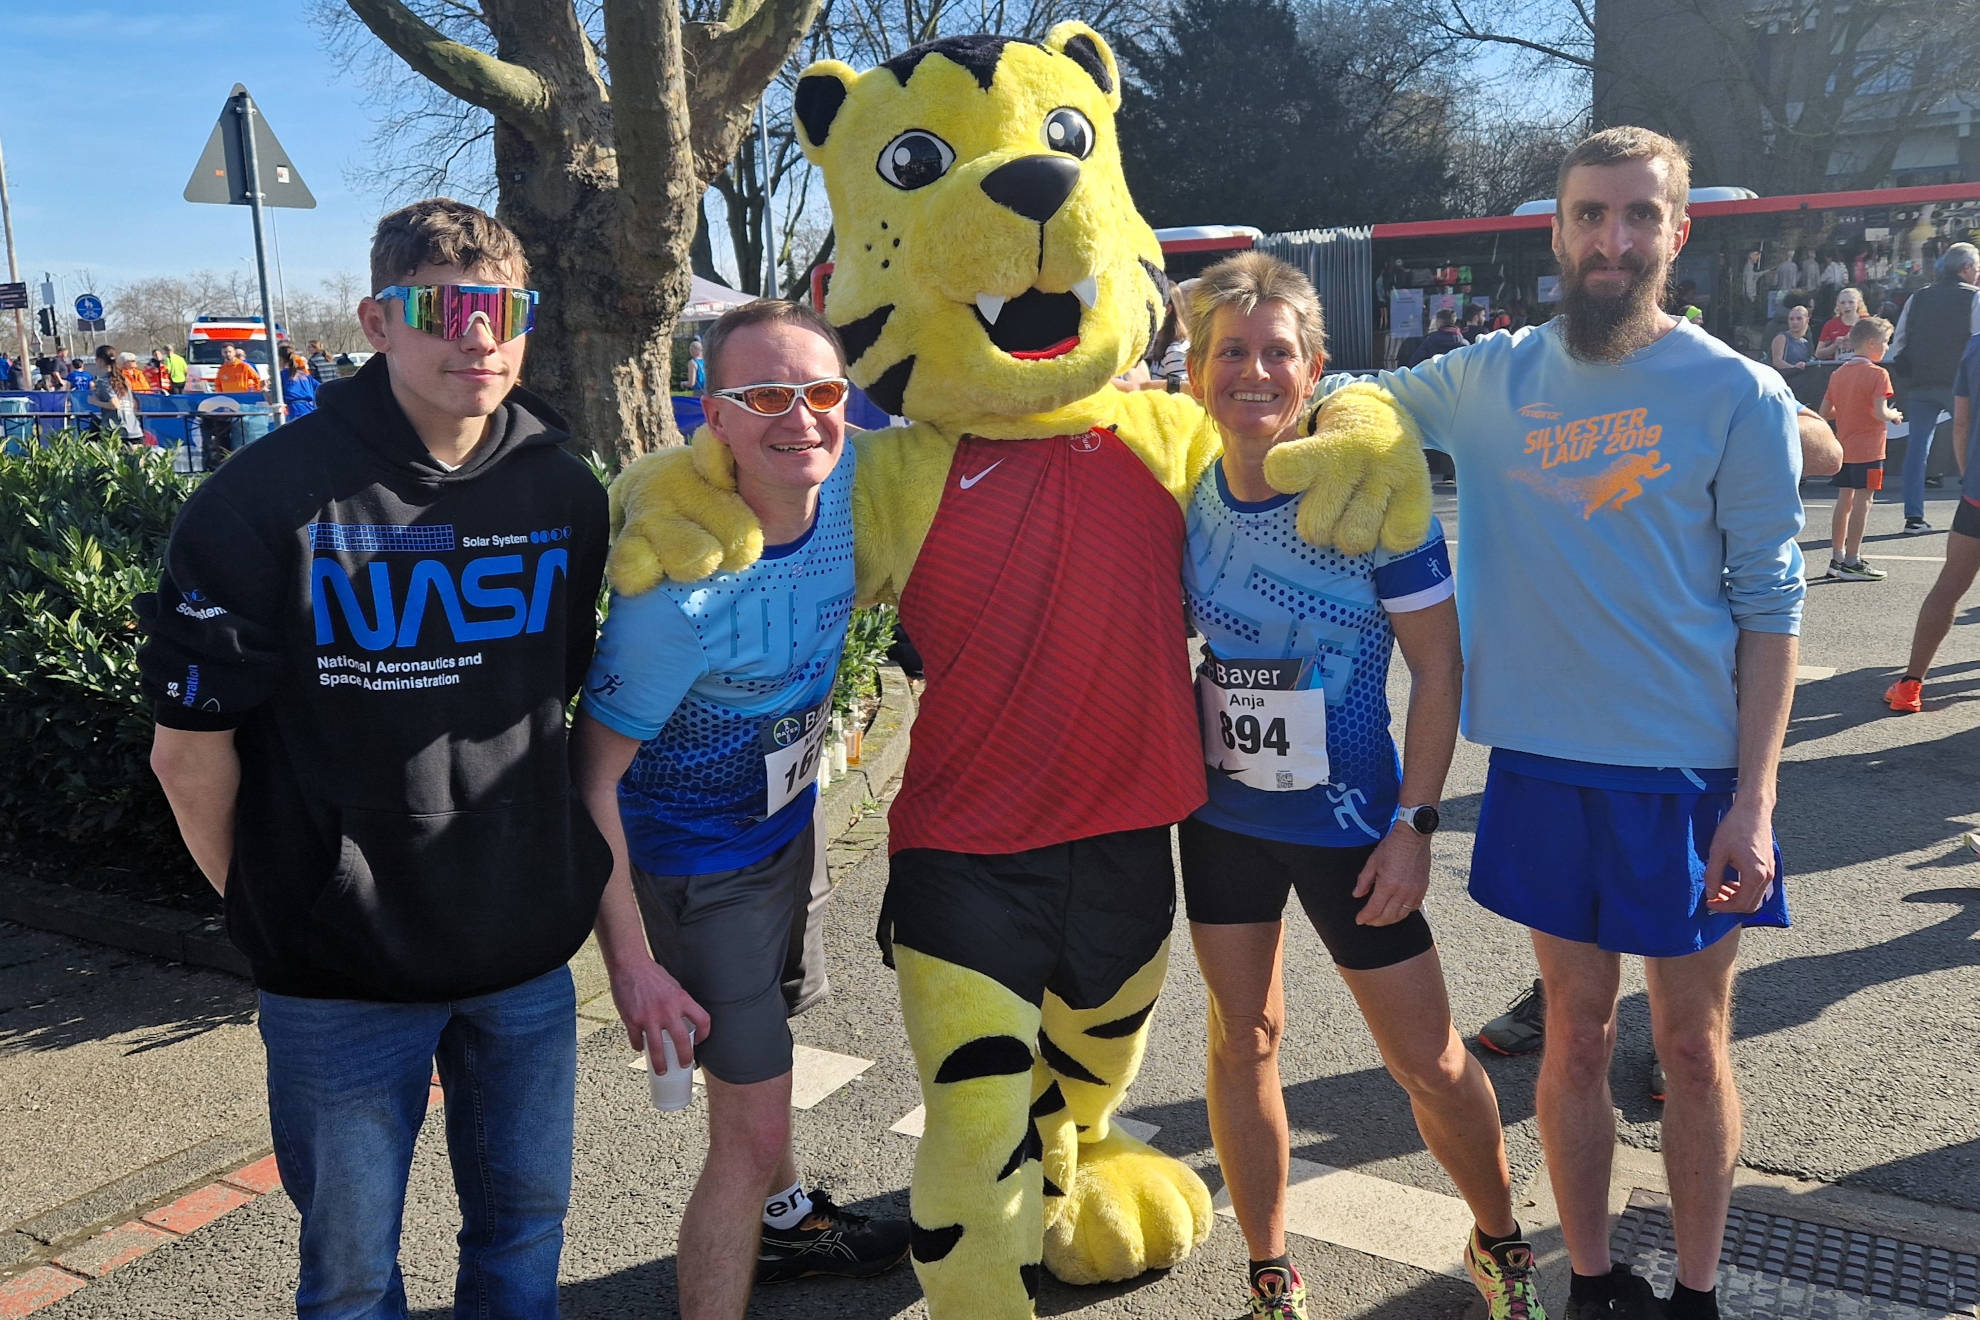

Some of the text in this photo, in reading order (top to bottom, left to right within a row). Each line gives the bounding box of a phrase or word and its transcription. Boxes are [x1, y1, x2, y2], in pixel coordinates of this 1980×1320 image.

[1523, 407, 1648, 454] SILVESTER
[1541, 424, 1663, 470] LAUF 2019
[462, 534, 529, 548] Solar System
[316, 652, 483, 673] National Aeronautics and
[319, 673, 460, 691] Space Administration
[1215, 663, 1281, 688] Bayer
[1229, 694, 1265, 710] Anja
[1219, 710, 1290, 757] 894
[766, 1187, 805, 1217] er
